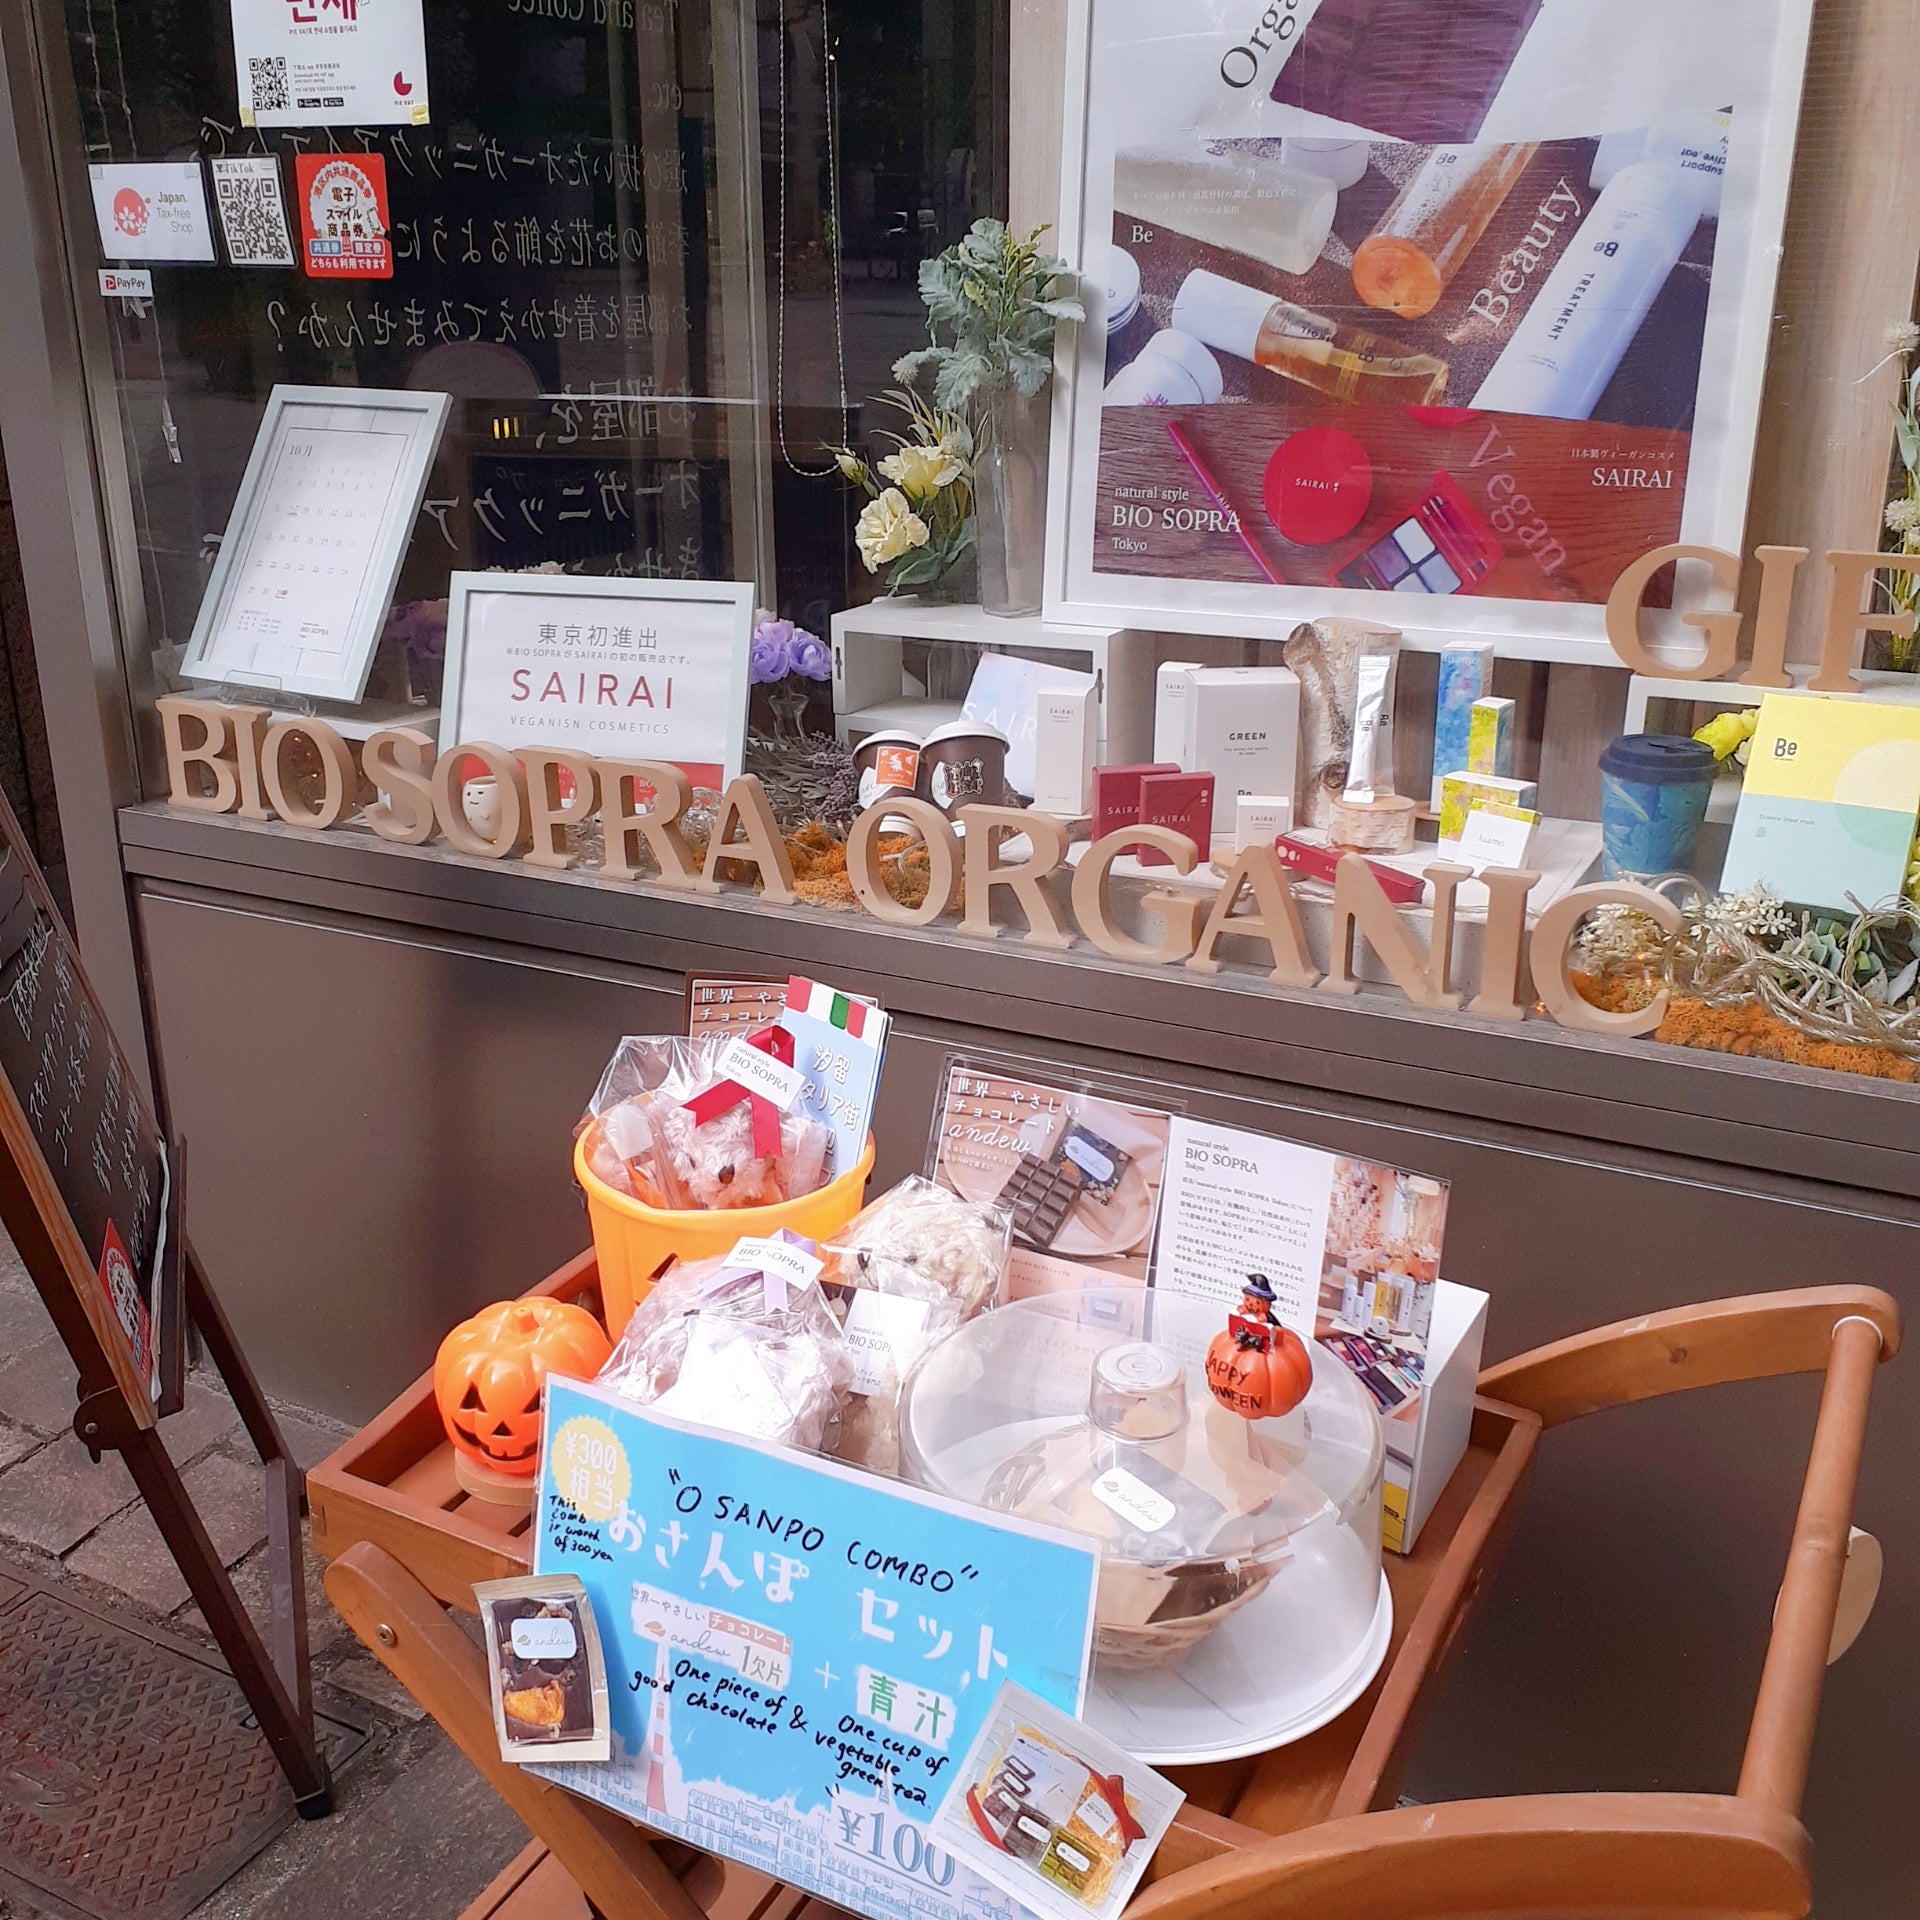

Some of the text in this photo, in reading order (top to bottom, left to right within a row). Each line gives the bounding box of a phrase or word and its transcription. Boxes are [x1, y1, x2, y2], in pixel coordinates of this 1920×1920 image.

[331, 187, 355, 202] 電子
[156, 207, 191, 219] Tax-free
[326, 208, 362, 221] スマイル
[170, 221, 193, 235] Shop
[327, 222, 363, 237] 商品券
[1131, 225, 1154, 243] Be
[1467, 176, 1582, 329] Beauty
[1593, 241, 1619, 258] Be
[311, 258, 387, 270] どちらも利用できます
[117, 278, 146, 289] PayPay
[1547, 272, 1595, 341] TREATMENT
[1571, 448, 1676, 461] 日本製ヴィーガンコスメ
[1294, 477, 1330, 491] SAIRAI
[1591, 467, 1674, 489] SAIRAI
[1115, 486, 1189, 503] natural style
[1469, 424, 1567, 576] Vegan
[1112, 504, 1242, 533] BIO SOPRA
[1112, 537, 1148, 553] Tokyo
[537, 622, 658, 650] 東京初進出
[510, 668, 673, 710] SAIRAI
[510, 715, 670, 735] VEGANISN COSMETICS
[1229, 732, 1267, 741] GREEN
[1774, 737, 1798, 757] Be
[1152, 814, 1191, 824] SAIRAI
[1250, 815, 1277, 823] SAIRAI
[1478, 833, 1505, 848] luamo
[156, 698, 1684, 1037] BIO SOPRA ORGANIC
[729, 1052, 789, 1094] BIO SOPRA
[813, 1043, 851, 1085] 汐留
[955, 1076, 1080, 1116] 世界一やさしい
[953, 1100, 1056, 1136] チョコレート
[948, 1123, 1032, 1154] andew
[1186, 1137, 1230, 1154] natural style
[1184, 1161, 1206, 1173] Tokyo
[1185, 1146, 1260, 1175] BIO SOPRA
[848, 1334, 867, 1347] BIO
[565, 1430, 617, 1475] ¥300
[570, 1467, 614, 1512] 相当
[549, 1495, 577, 1511] This
[713, 1495, 825, 1552] SANPO
[608, 1500, 1008, 1682] おさんぽ セット
[670, 1630, 731, 1657] andew
[740, 1644, 784, 1687] 1欠片
[629, 1670, 675, 1693] good
[674, 1659, 808, 1734] One piece of &
[867, 1672, 947, 1740] 青汁
[815, 1731, 901, 1777] vegetable
[837, 1715, 950, 1777] One cup of
[836, 1761, 884, 1789] green
[833, 1804, 955, 1888] ¥100
